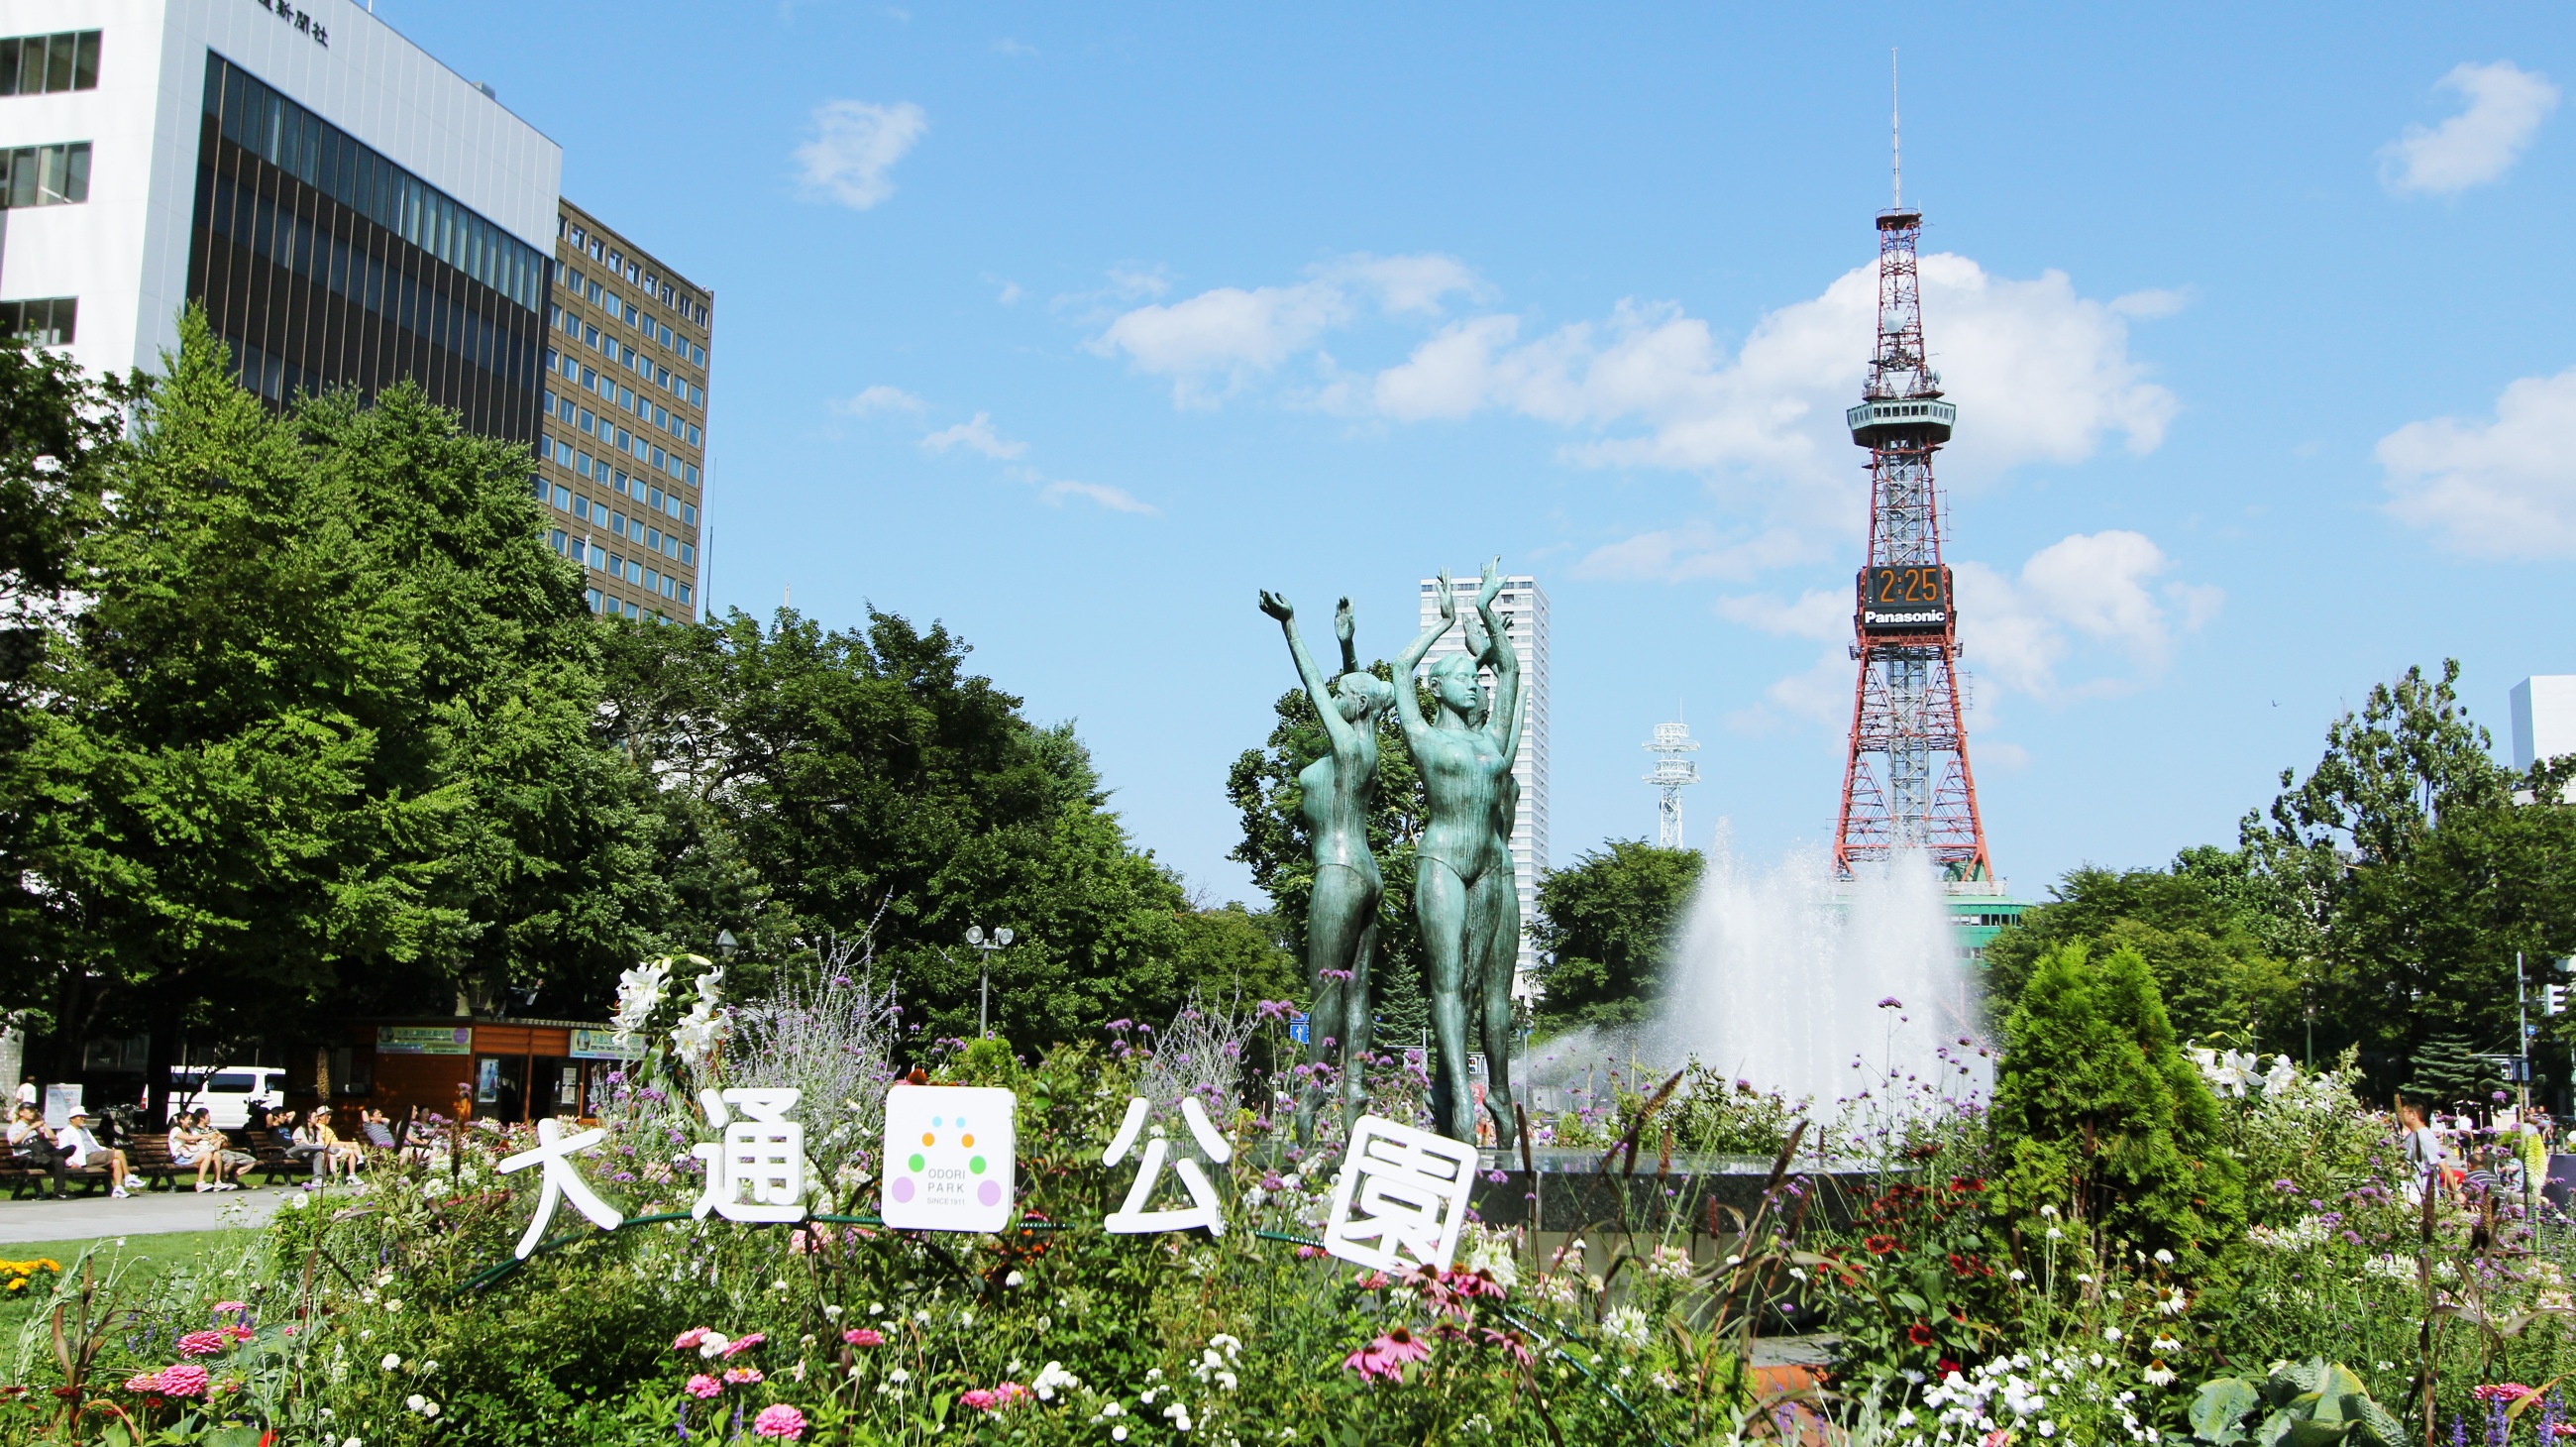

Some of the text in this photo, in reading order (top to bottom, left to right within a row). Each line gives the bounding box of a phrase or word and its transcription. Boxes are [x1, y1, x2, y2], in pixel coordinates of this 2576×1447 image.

[1865, 609, 1946, 624] Panasonic
[928, 1169, 965, 1179] ODORI
[498, 1087, 1480, 1277] 大通公園
[927, 1182, 964, 1193] PARK
